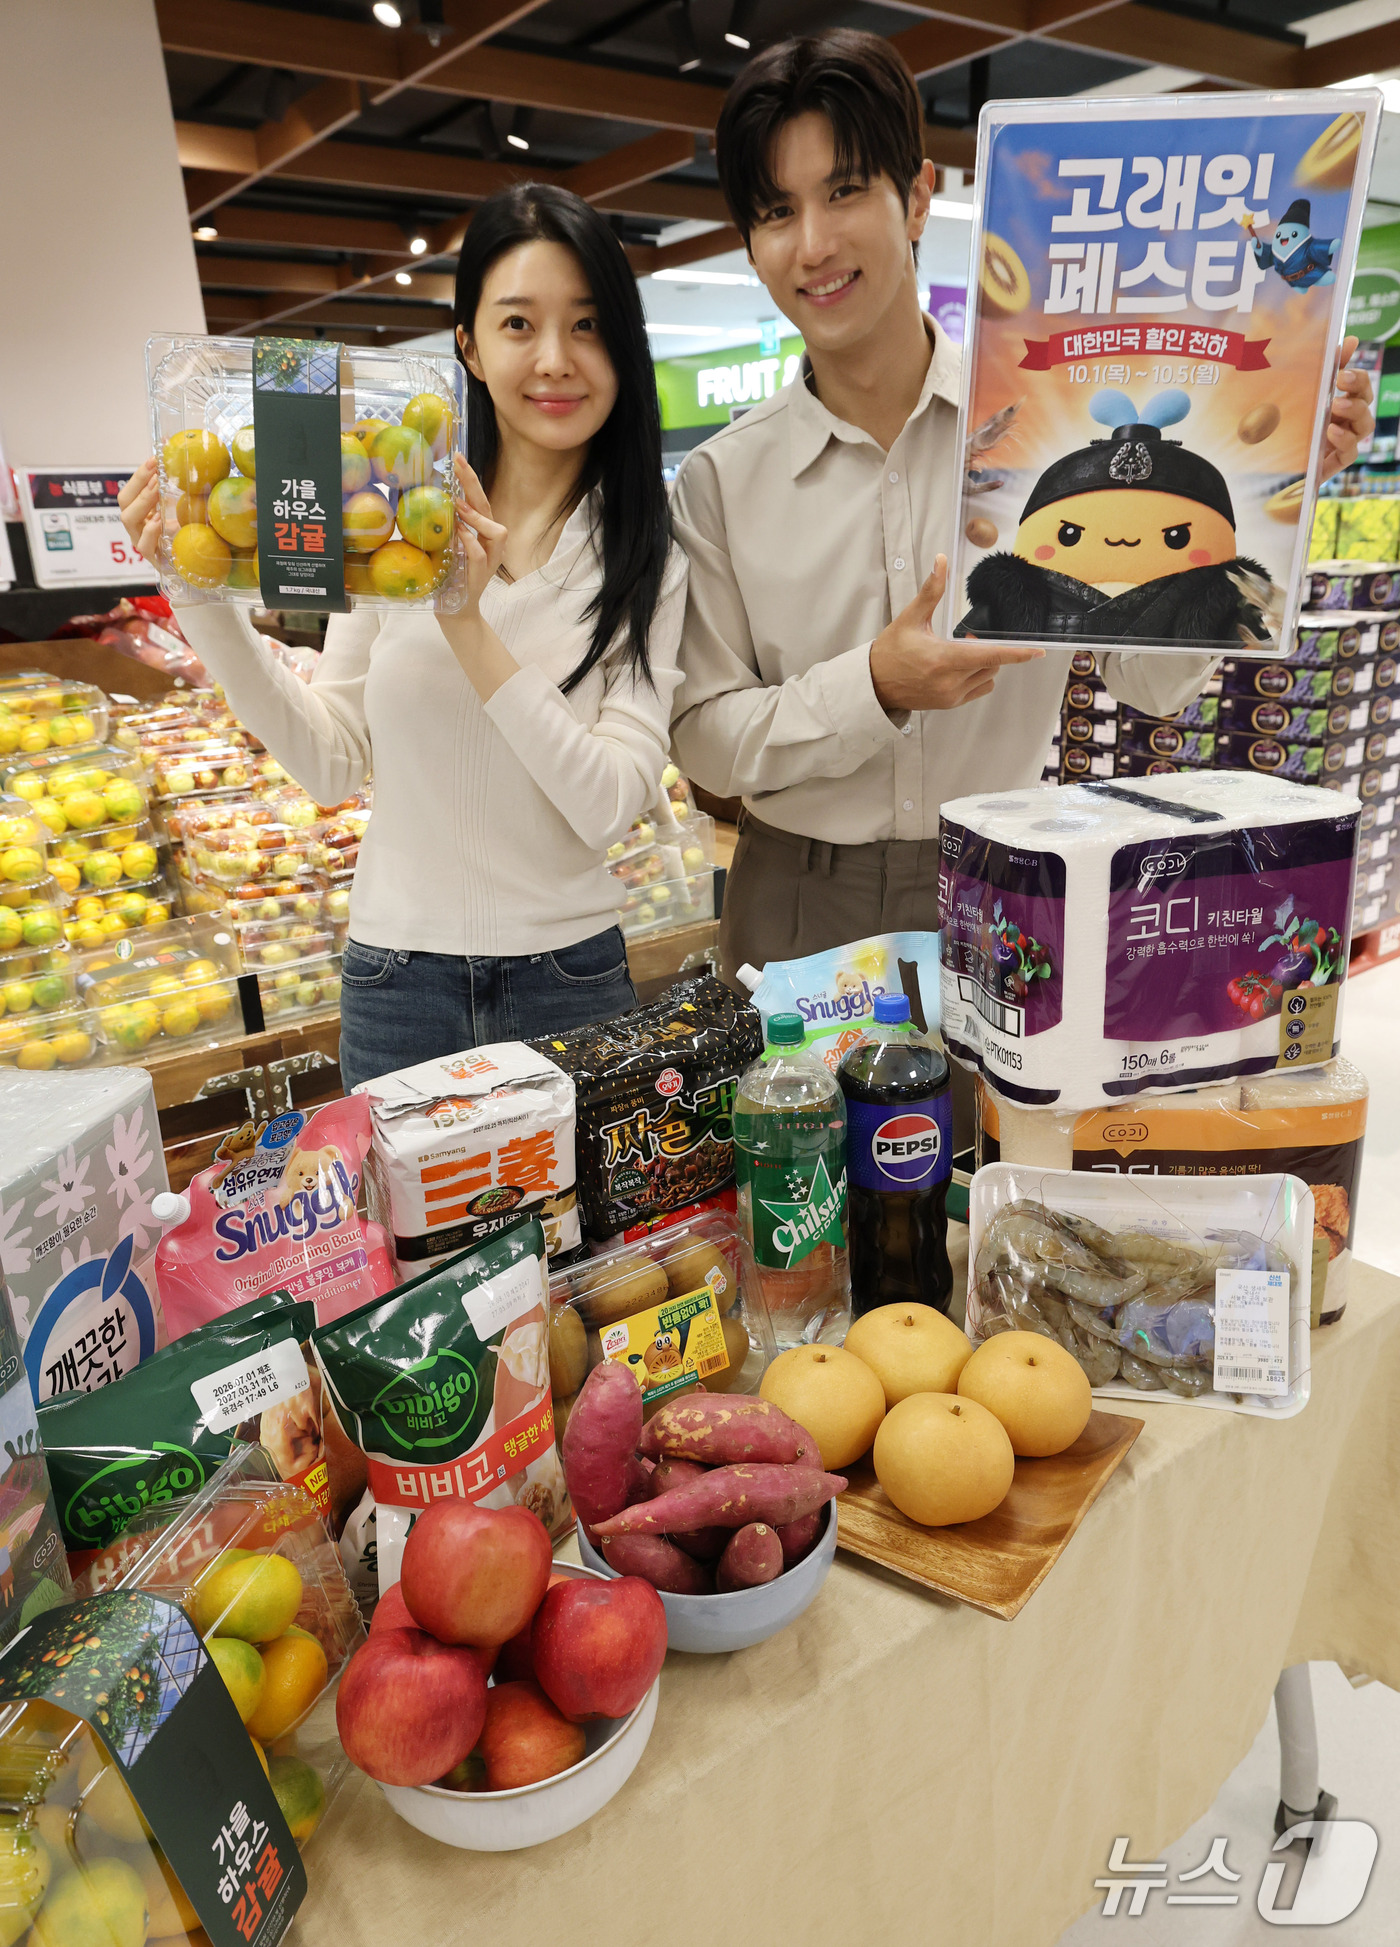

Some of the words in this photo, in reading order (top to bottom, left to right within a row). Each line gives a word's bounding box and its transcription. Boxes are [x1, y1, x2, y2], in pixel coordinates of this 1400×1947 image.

[1051, 153, 1275, 233] 고래잇
[1043, 240, 1267, 314] 페스타
[1063, 328, 1141, 357] 대한민국
[1145, 327, 1185, 352] 할인
[1188, 330, 1229, 358] 천하
[697, 357, 780, 408] FRUIT
[1066, 363, 1131, 385] 10.1(목)
[1152, 363, 1221, 386] 10.5(월)
[281, 478, 317, 500] 가을
[272, 499, 327, 521] 하우스
[274, 522, 327, 553] 감귤
[1126, 896, 1200, 942] 코디
[1207, 907, 1264, 928] 키친타월
[1126, 943, 1156, 961] 강력한
[1156, 937, 1206, 957] 흡수력으로
[1207, 933, 1240, 949] 한번에
[1241, 931, 1256, 945] 쏙!
[795, 980, 886, 1023] Snuggle
[990, 1040, 1023, 1071] PTK01153
[1121, 1053, 1158, 1071] 150매
[630, 1096, 645, 1108] 풍미
[661, 1079, 678, 1092] 오뚜기
[602, 1077, 738, 1164] 짜슐랭
[430, 1145, 466, 1160] Samyang
[876, 1134, 938, 1156] PEPSI
[222, 1164, 286, 1198] 섬유유연제
[1168, 1164, 1196, 1176] 기름기
[62, 1215, 82, 1239] 필요한
[83, 1205, 97, 1223] 순간
[771, 1164, 848, 1254] Chilsung
[812, 1201, 842, 1242] CIDER
[234, 1262, 276, 1292] Original
[275, 1242, 331, 1274] Blooming
[305, 1265, 334, 1287] 블루밍
[661, 1303, 698, 1329] 빈틈없이
[698, 1296, 710, 1310] 꽉!
[45, 1307, 127, 1397] 깨끗한
[605, 1334, 626, 1351] Zespri
[212, 1370, 257, 1398] 2026.07.01
[216, 1379, 260, 1407] 2027.03.31
[381, 1371, 472, 1415] bibigo
[1266, 1375, 1286, 1383] 18825
[221, 1399, 245, 1417] 유경수
[245, 1387, 267, 1405] 17:49
[268, 1381, 280, 1393] L6
[406, 1410, 448, 1431] 비비고
[503, 1423, 540, 1458] 탱글한
[395, 1451, 495, 1504] 비비고
[75, 1466, 195, 1528] bibigo
[211, 1800, 251, 1866] 가을
[216, 1820, 270, 1904] 하우스
[231, 1841, 284, 1943] 감귤
